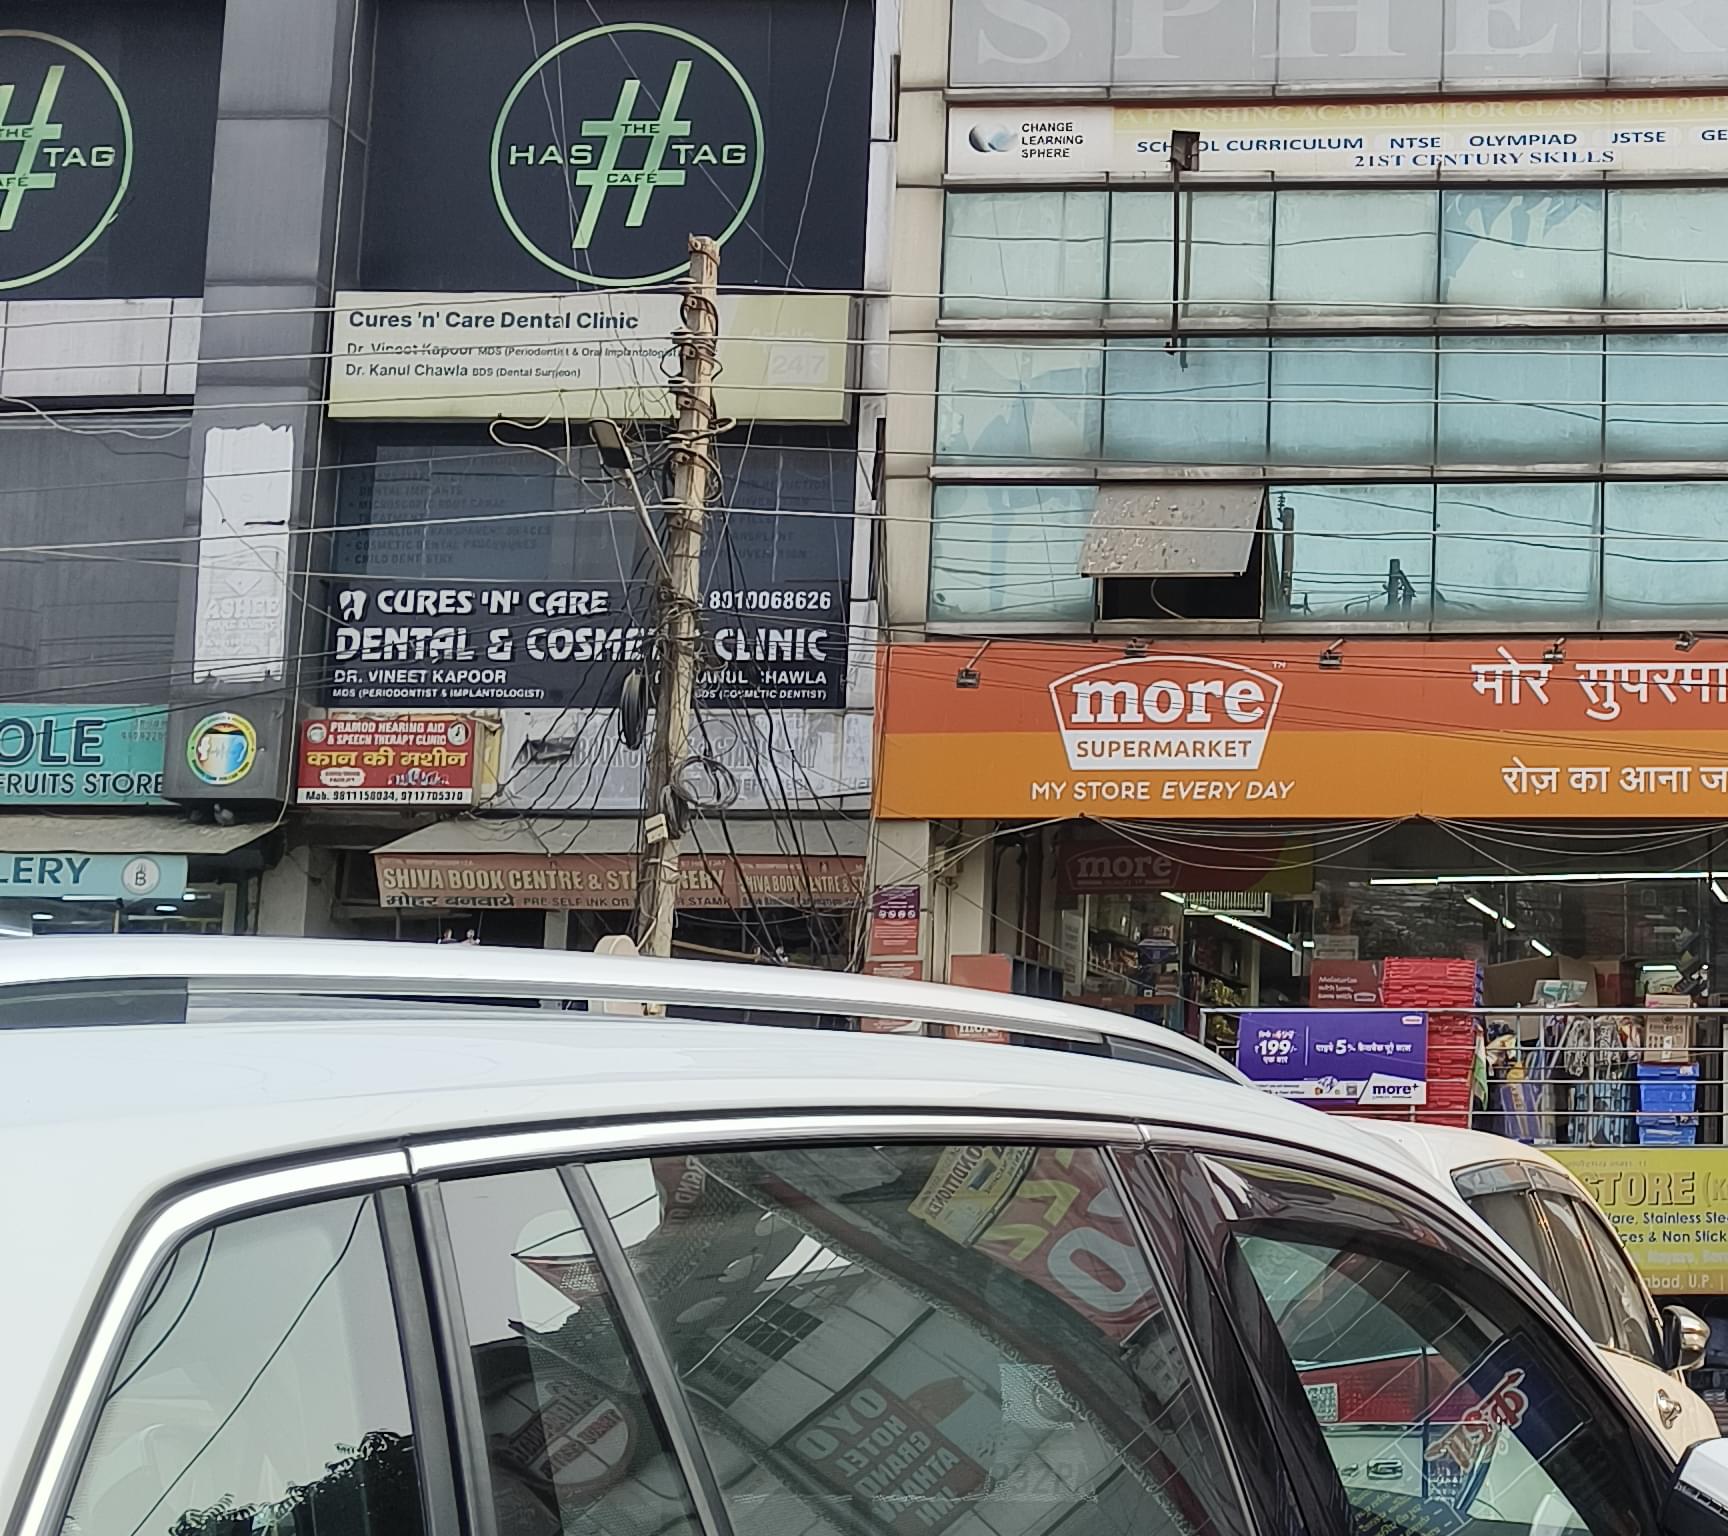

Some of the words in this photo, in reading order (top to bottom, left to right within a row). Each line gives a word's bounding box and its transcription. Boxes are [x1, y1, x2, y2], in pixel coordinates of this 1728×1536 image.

[1021, 134, 1084, 146] LEARNING
[1226, 137, 1364, 153] CURRICULUM
[1389, 135, 1441, 150] NTSE
[1469, 132, 1577, 148] OLYMPIAD
[1611, 131, 1666, 145] JSTSE
[43, 145, 115, 168] TAG
[1355, 154, 1403, 168] 21ST
[1410, 150, 1524, 167] CENTURY
[1530, 149, 1615, 165] SKILLS
[349, 311, 413, 329] Cures
[446, 311, 495, 329] Care
[500, 310, 571, 329] Dental
[576, 310, 639, 329] Clinic
[369, 362, 410, 378] Kanul
[414, 362, 468, 378] Chawla
[376, 590, 474, 616] CURES
[527, 591, 609, 616] CARE
[336, 627, 475, 663] DENTAL
[714, 628, 830, 662] CLINIC
[368, 670, 427, 684] VINEET
[432, 670, 507, 684] KAPOOR
[1470, 646, 1553, 706] मोर
[1070, 679, 1265, 724] more
[307, 751, 358, 767] कान
[363, 746, 396, 767] की
[1076, 740, 1252, 759] SUPERMARKET
[1030, 782, 1066, 802] MY
[1072, 781, 1151, 801] STORE
[1161, 781, 1240, 801] EVERY
[1244, 780, 1295, 800] DAY
[1568, 766, 1609, 795] का
[1618, 766, 1692, 795] आना
[383, 867, 444, 890] SHIVA
[448, 868, 505, 890] BOOK
[508, 869, 583, 891] CENTRE
[1642, 1211, 1701, 1225] Stainless
[1662, 1230, 1690, 1243] Non
[1694, 1229, 1727, 1243] Stick
